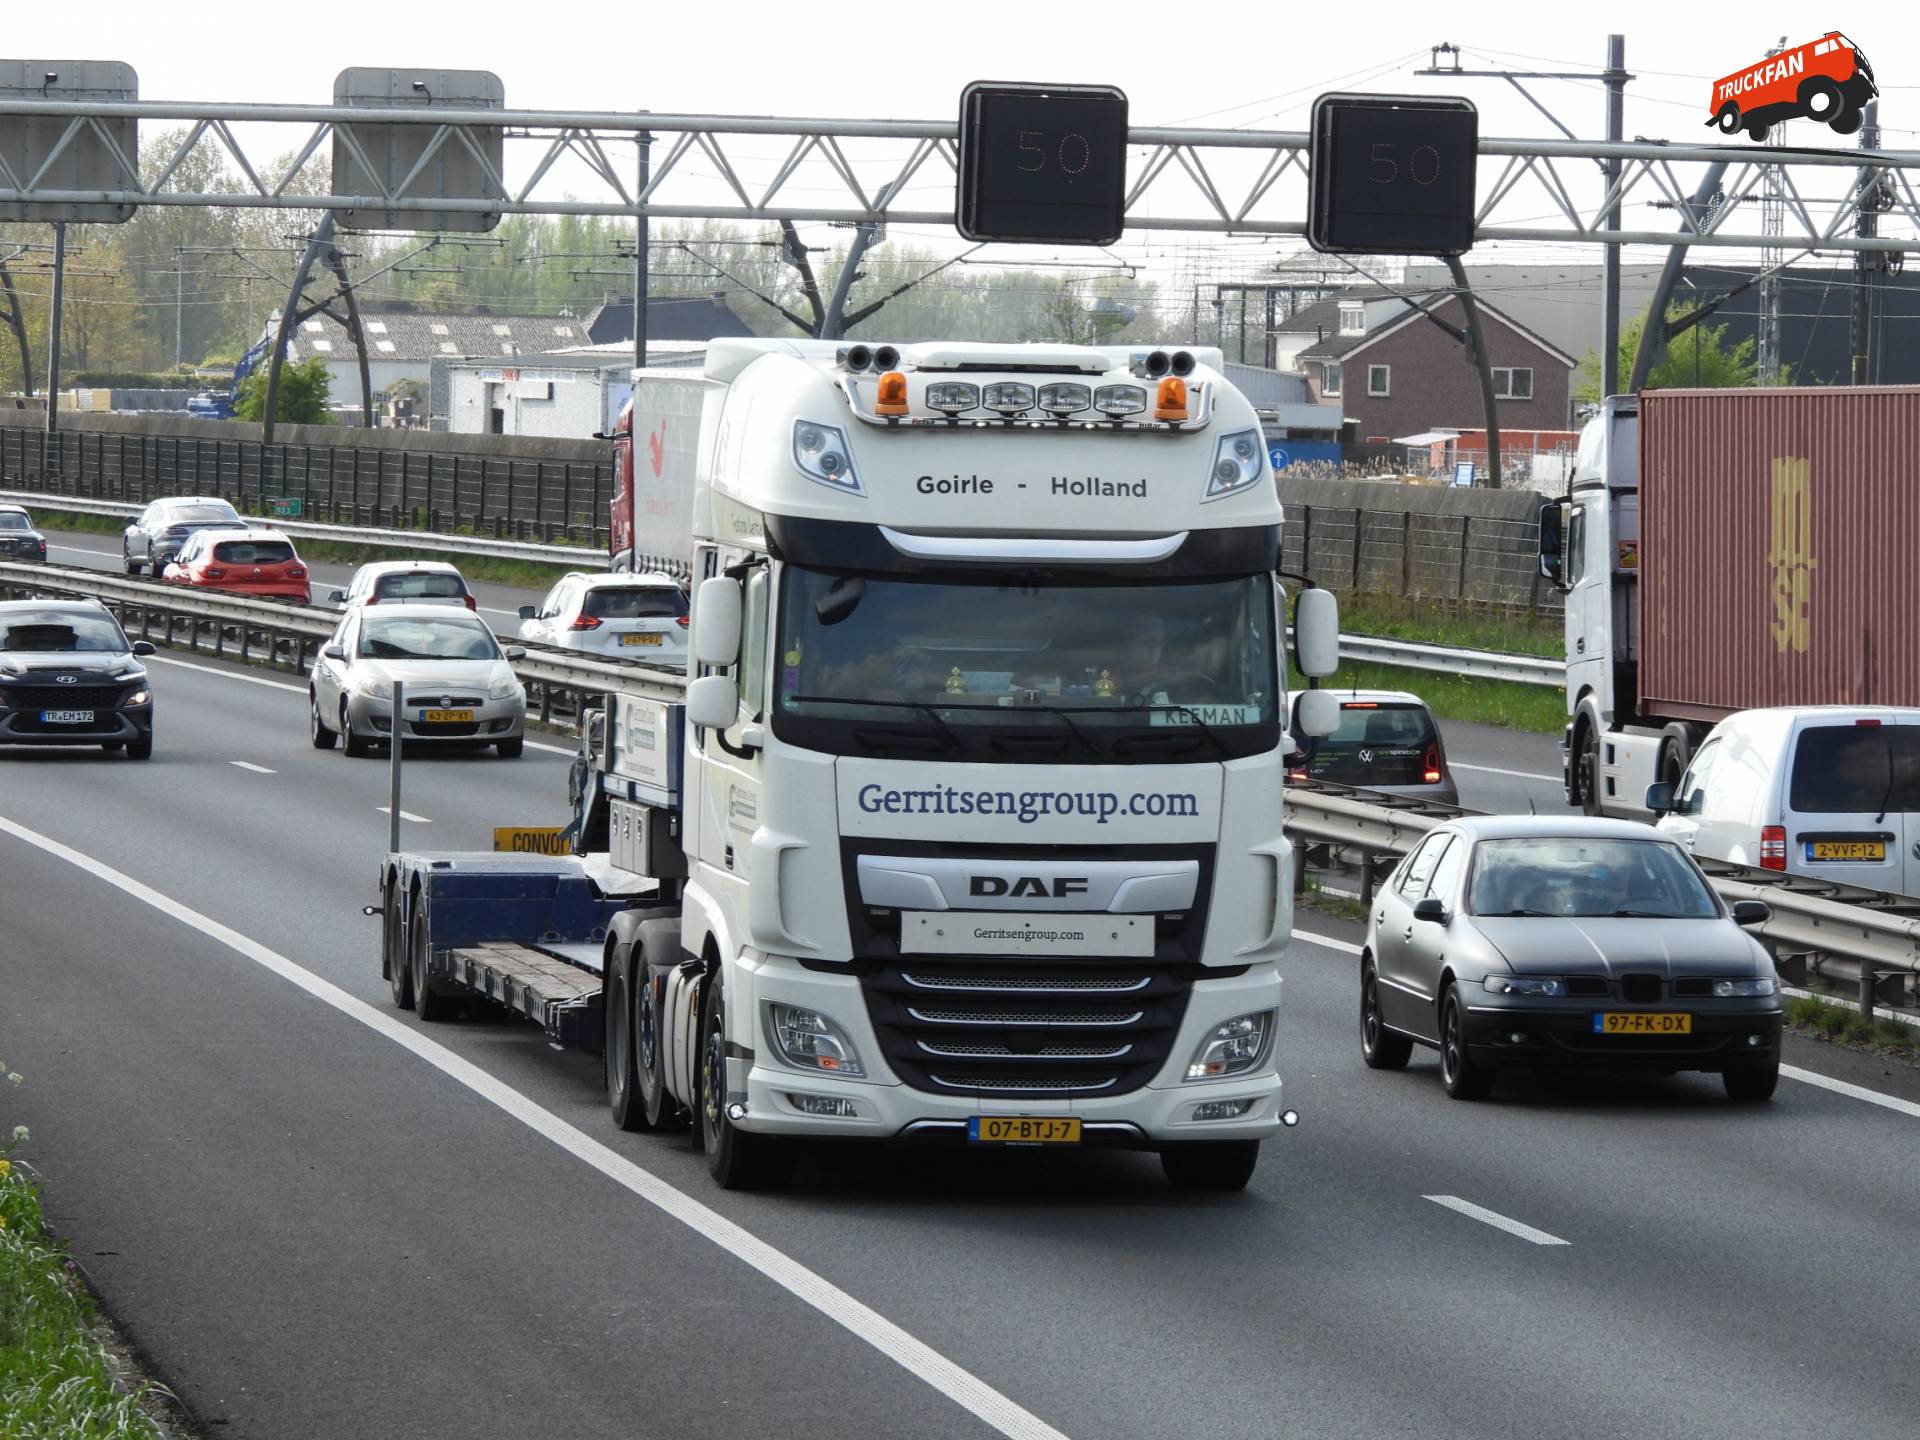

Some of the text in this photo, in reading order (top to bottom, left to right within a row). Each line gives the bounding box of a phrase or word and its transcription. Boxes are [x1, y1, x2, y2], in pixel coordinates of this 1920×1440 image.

[1018, 131, 1089, 174] 50
[1369, 143, 1440, 185] 50
[916, 475, 994, 495] Goirle
[1051, 477, 1148, 498] Holland
[858, 783, 1200, 824] Gerritsengroup.com
[1819, 844, 1876, 857] 2-VVF-12
[969, 876, 1089, 898] DAF
[974, 928, 1085, 942] Gerritsengroup.com
[1608, 1015, 1685, 1031] 97-FK-DX
[988, 1121, 1072, 1139] 07-BTJ-7
